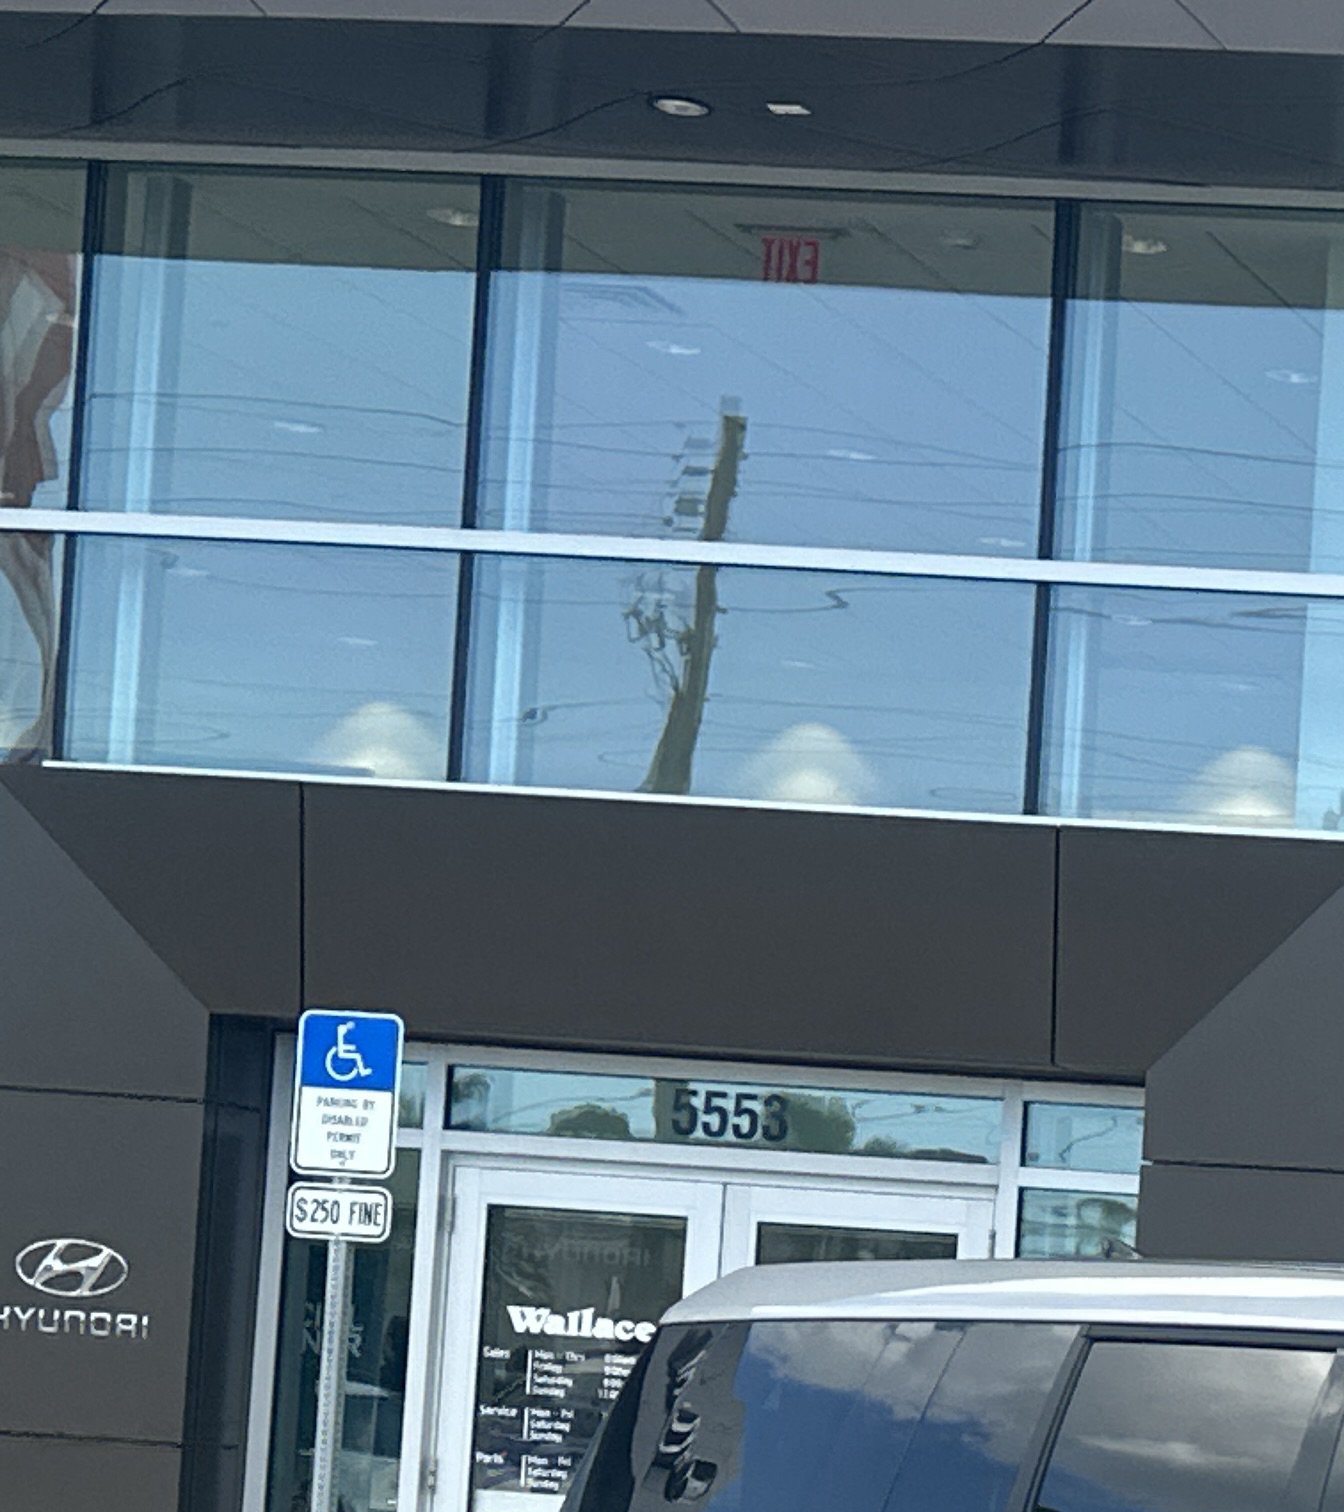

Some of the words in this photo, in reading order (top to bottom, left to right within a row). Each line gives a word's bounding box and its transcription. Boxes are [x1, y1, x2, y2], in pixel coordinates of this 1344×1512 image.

[316, 1095, 358, 1109] PARKING
[362, 1099, 376, 1111] BY
[321, 1113, 369, 1127] DISABLED
[671, 1087, 789, 1143] 5553
[326, 1130, 362, 1144] PERMIT
[330, 1149, 356, 1161] ONLY
[294, 1196, 341, 1225] $250
[348, 1201, 384, 1227] FINE
[506, 1304, 658, 1343] Wallace
[479, 1404, 519, 1418] Service
[475, 1450, 505, 1464] Parts
